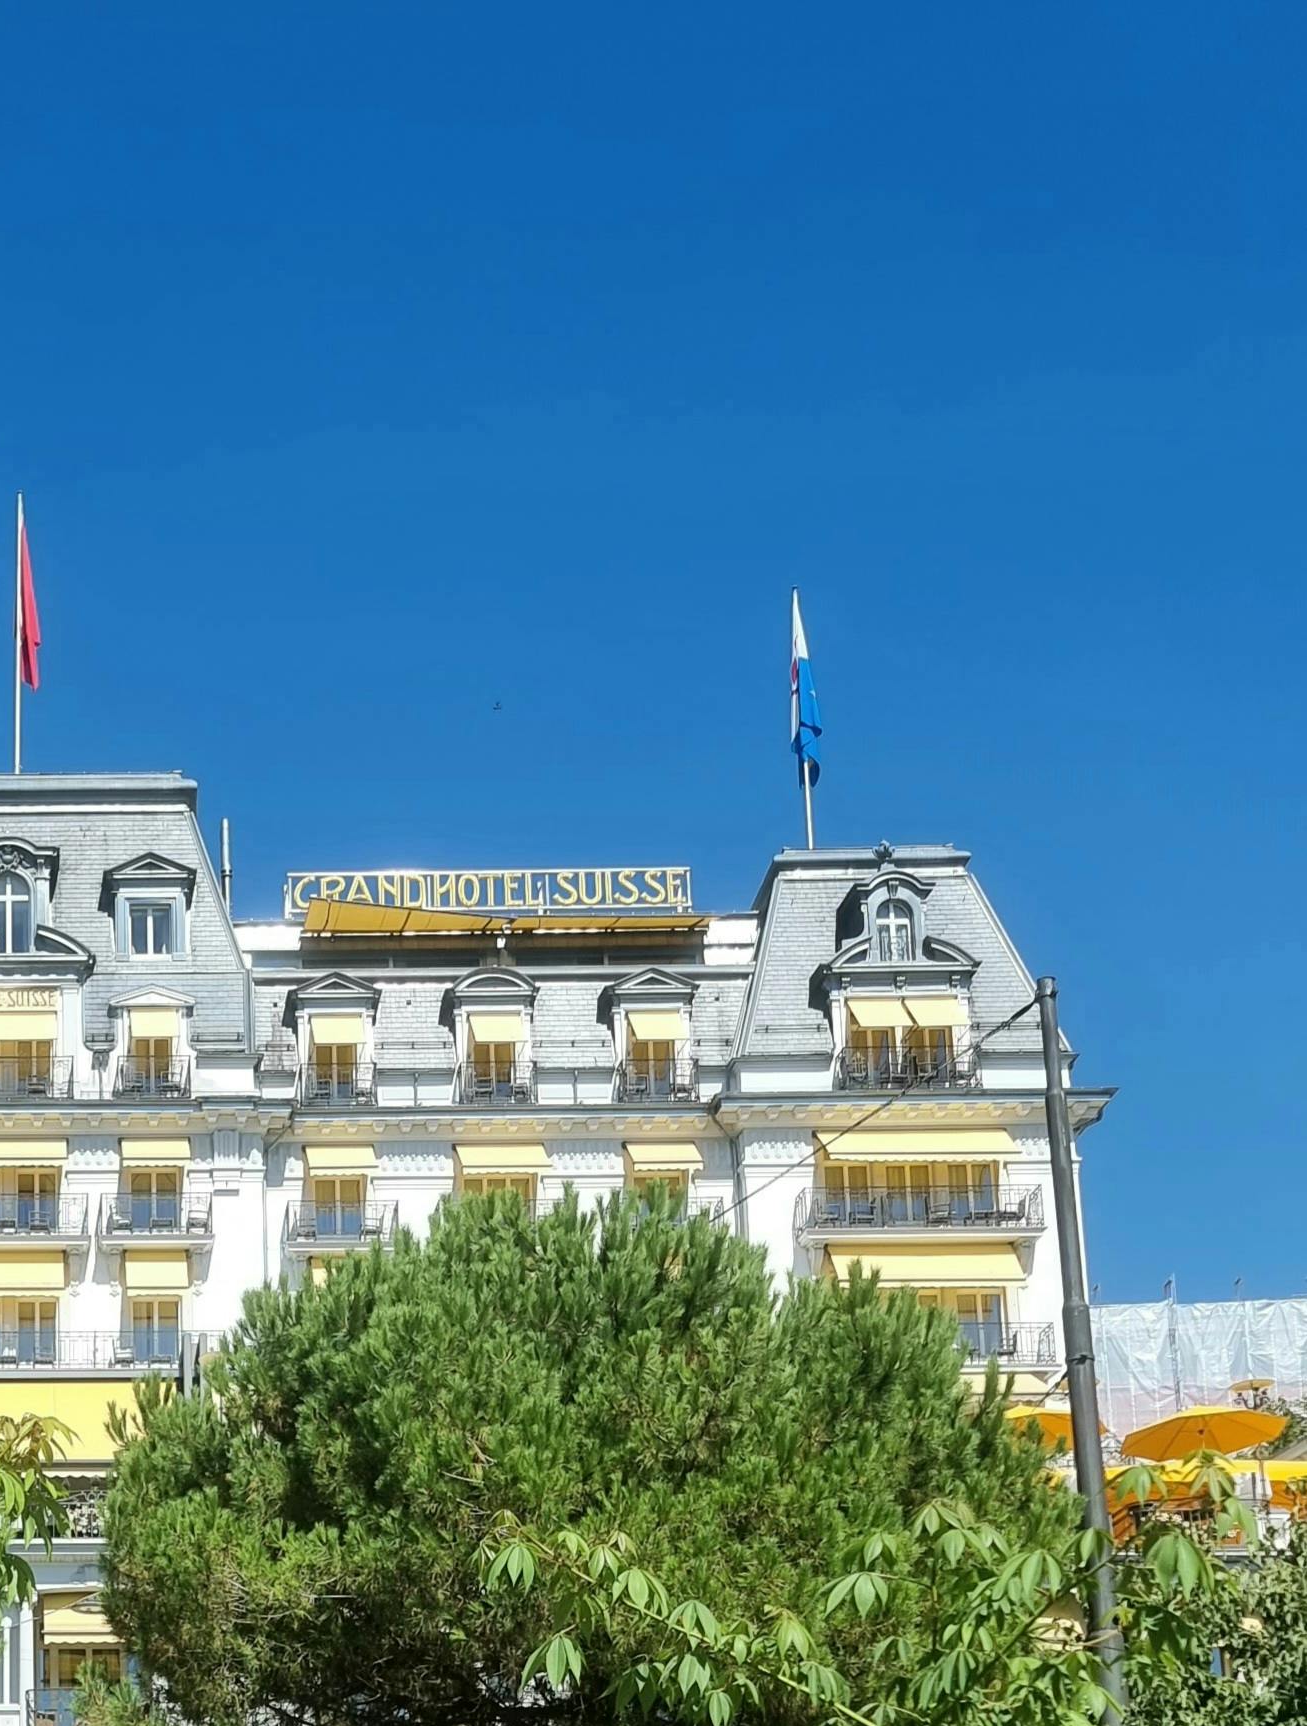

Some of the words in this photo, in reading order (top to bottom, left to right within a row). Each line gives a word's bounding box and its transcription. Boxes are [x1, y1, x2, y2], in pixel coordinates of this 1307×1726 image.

[433, 873, 543, 908] HOTEL
[553, 870, 687, 906] SUISSE
[7, 991, 55, 1007] SUISSE
